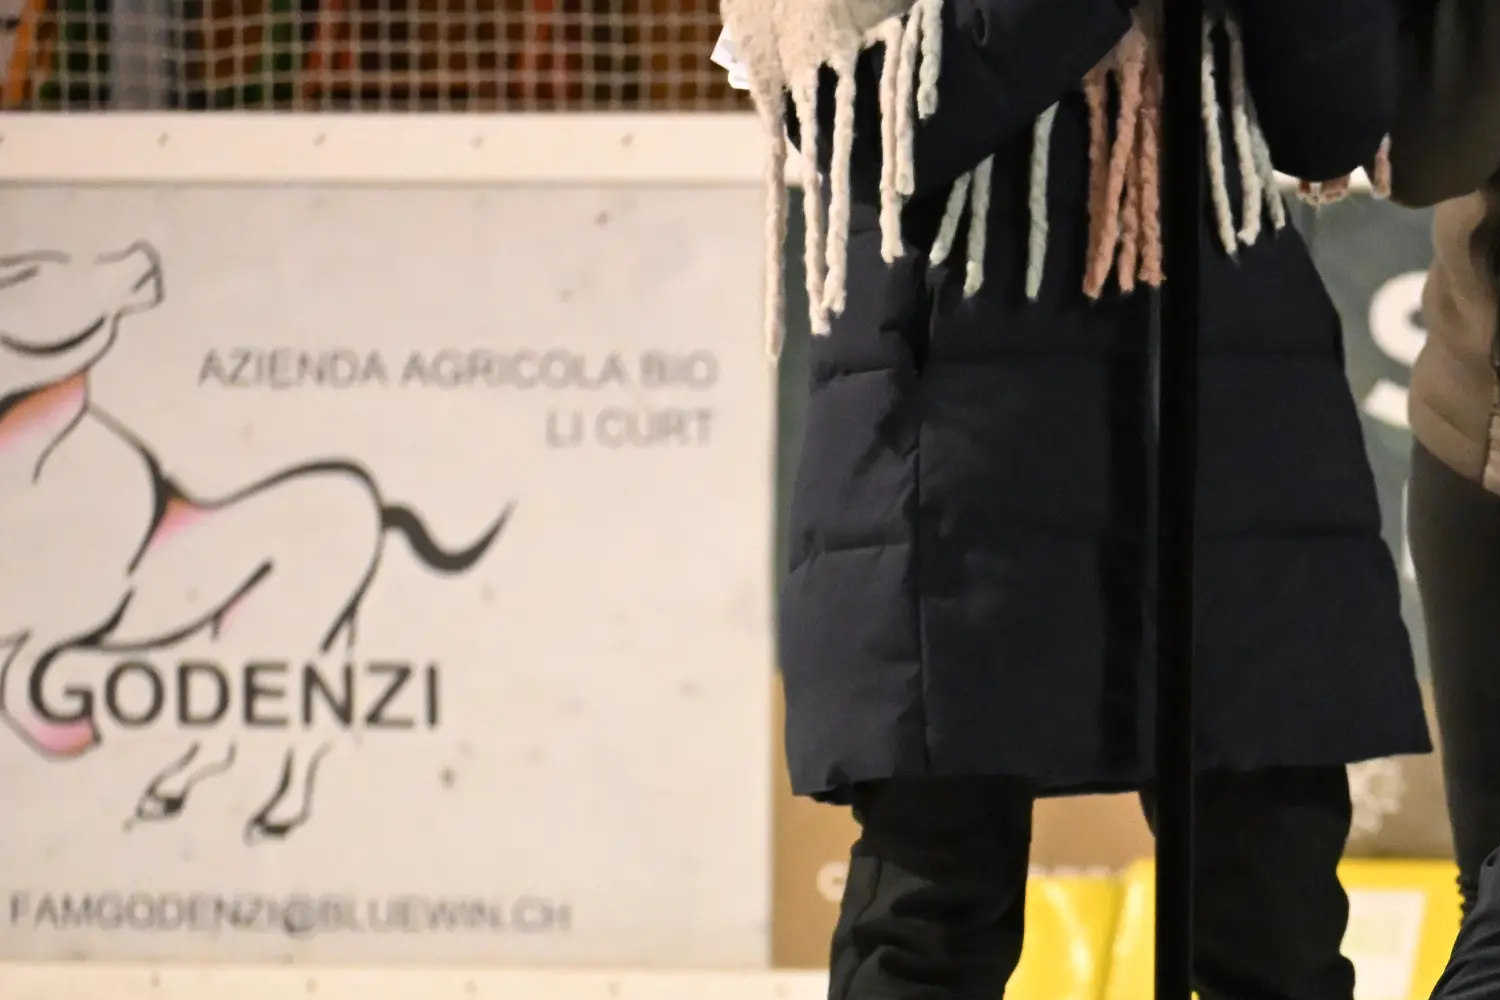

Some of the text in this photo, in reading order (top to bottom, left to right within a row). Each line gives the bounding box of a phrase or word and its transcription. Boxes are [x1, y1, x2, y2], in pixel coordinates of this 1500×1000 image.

[197, 347, 719, 390] AZIENDA AGRICOLA BIO
[545, 407, 715, 449] LI CURT
[28, 648, 442, 730] GODENZI
[8, 889, 574, 938] FAMGODENZI@BLUEWIN.CH
